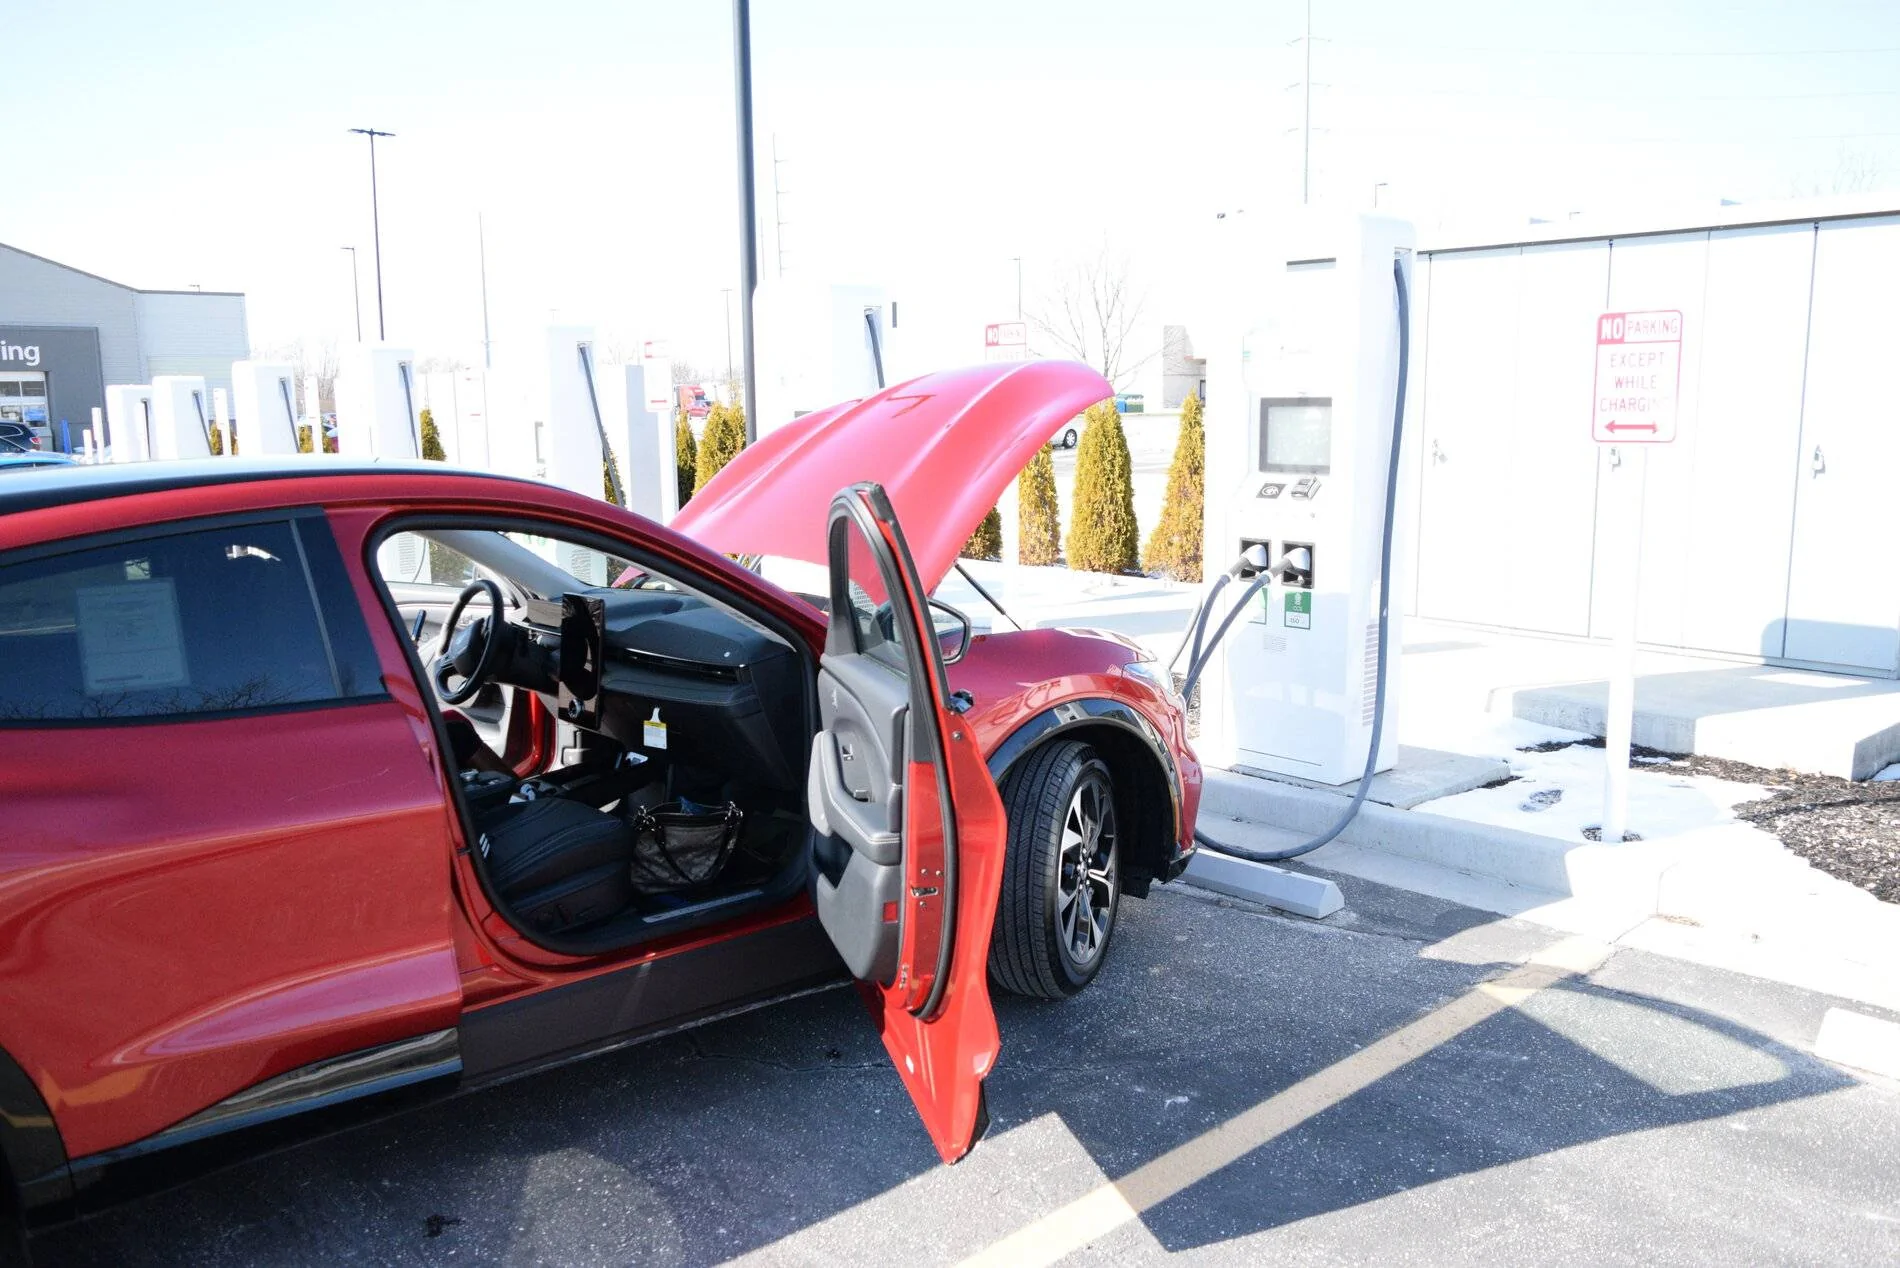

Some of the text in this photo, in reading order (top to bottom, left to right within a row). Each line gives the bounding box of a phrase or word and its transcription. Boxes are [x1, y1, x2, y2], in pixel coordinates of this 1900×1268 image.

[1601, 317, 1677, 339] NO PARKING
[0, 340, 40, 366] ing
[1610, 351, 1664, 368] EXCEPT
[1614, 374, 1657, 389] WHILE
[1600, 396, 1669, 412] CHARGI
